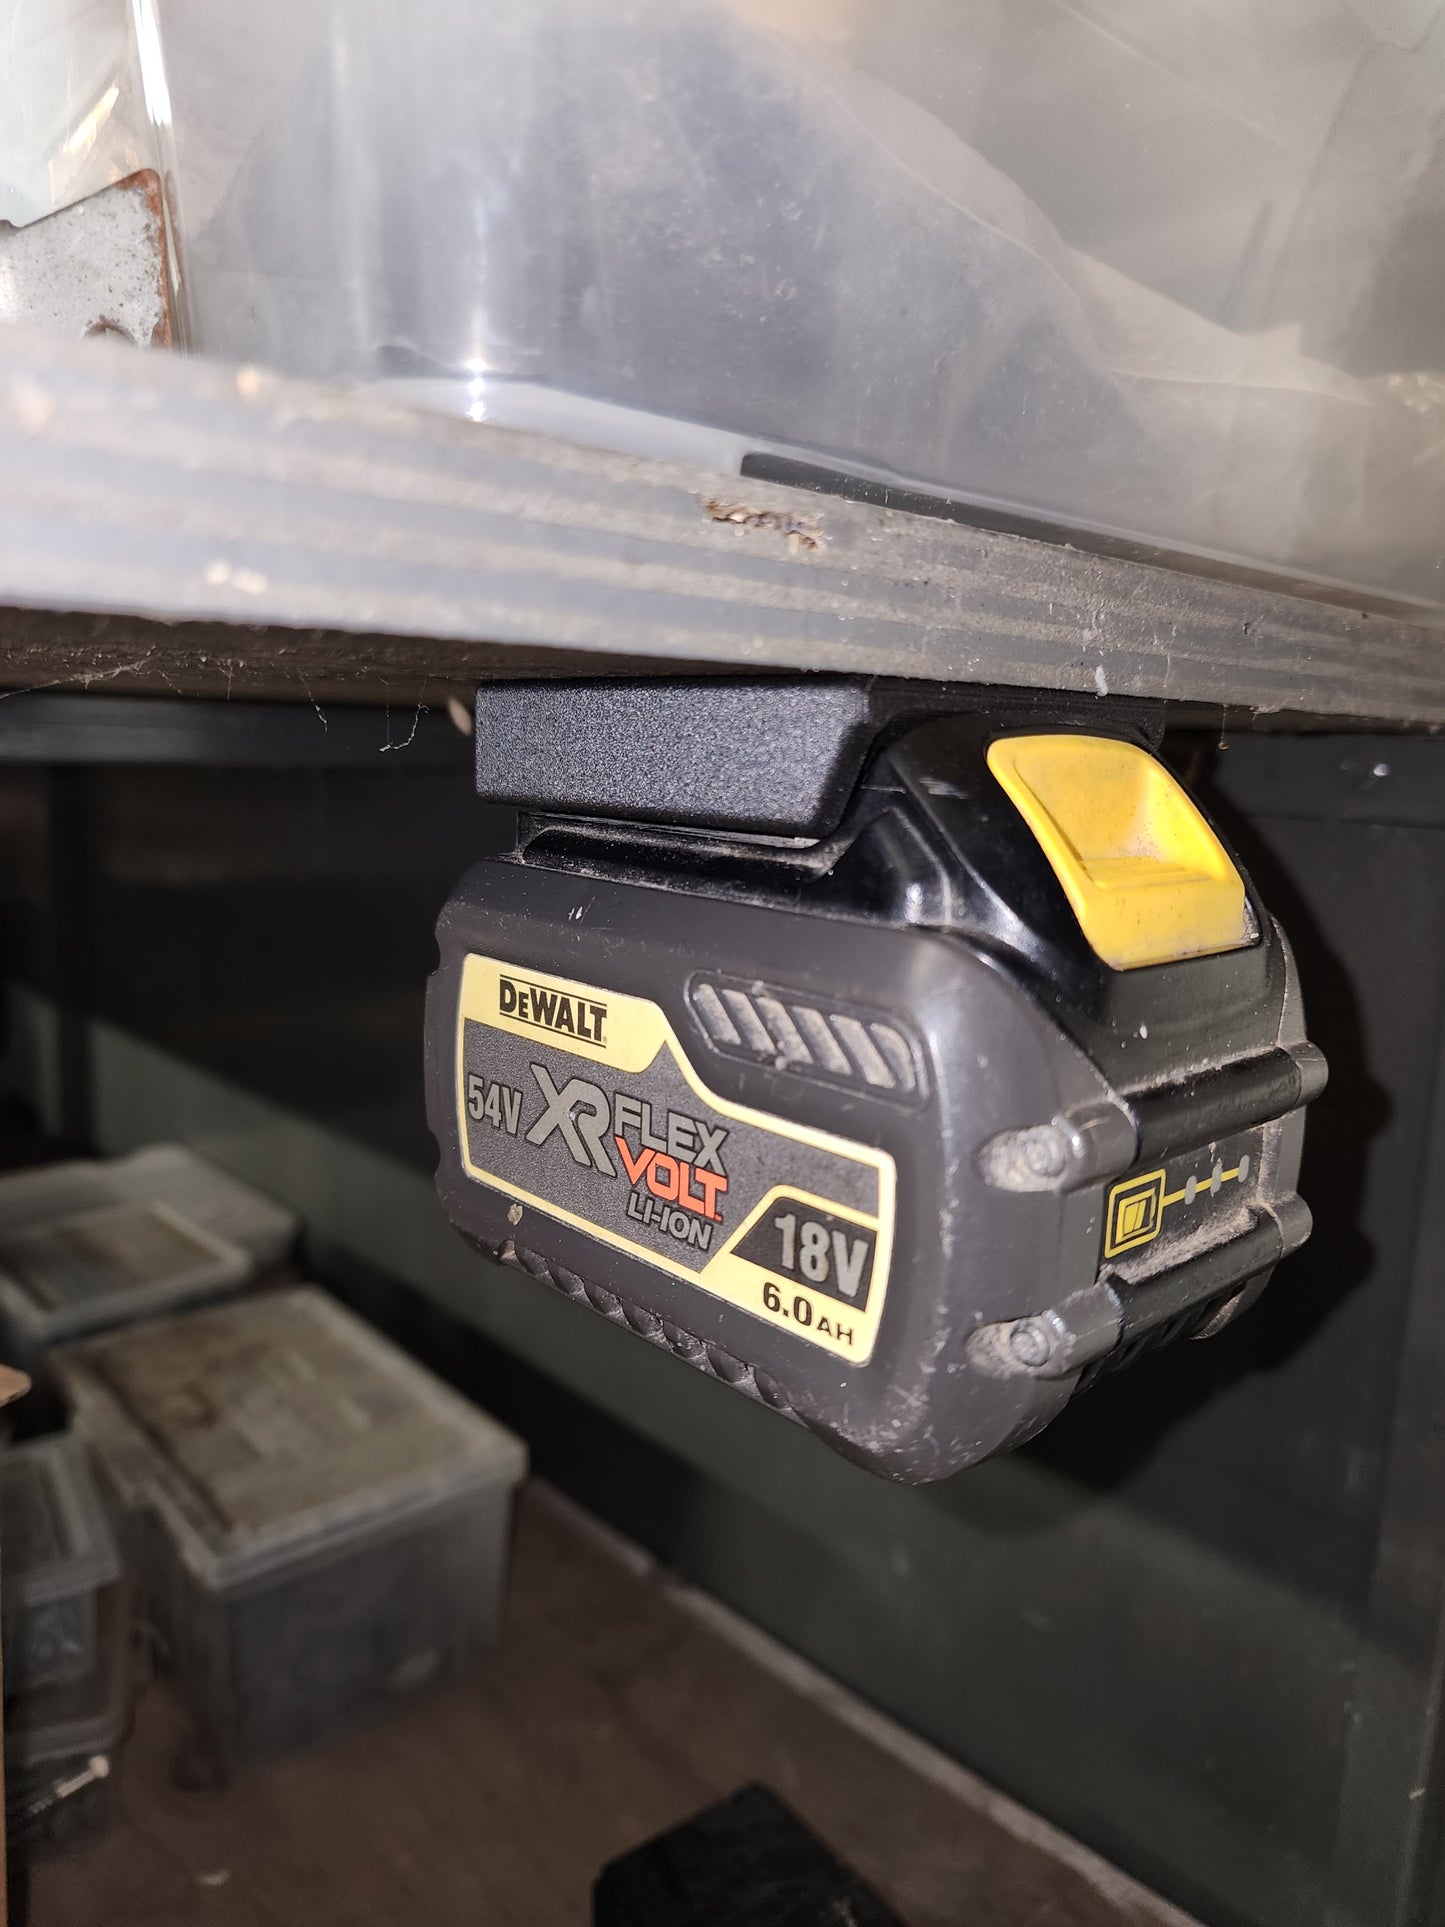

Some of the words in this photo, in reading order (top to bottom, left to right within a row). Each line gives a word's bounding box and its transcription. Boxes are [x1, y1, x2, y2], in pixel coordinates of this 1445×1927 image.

[467, 1075, 522, 1135] 54V
[527, 1063, 617, 1177] XR
[615, 1093, 729, 1173] FLEX
[615, 1136, 728, 1219] VOLT
[628, 1191, 712, 1250] LI-ION
[774, 1213, 869, 1298] 18V
